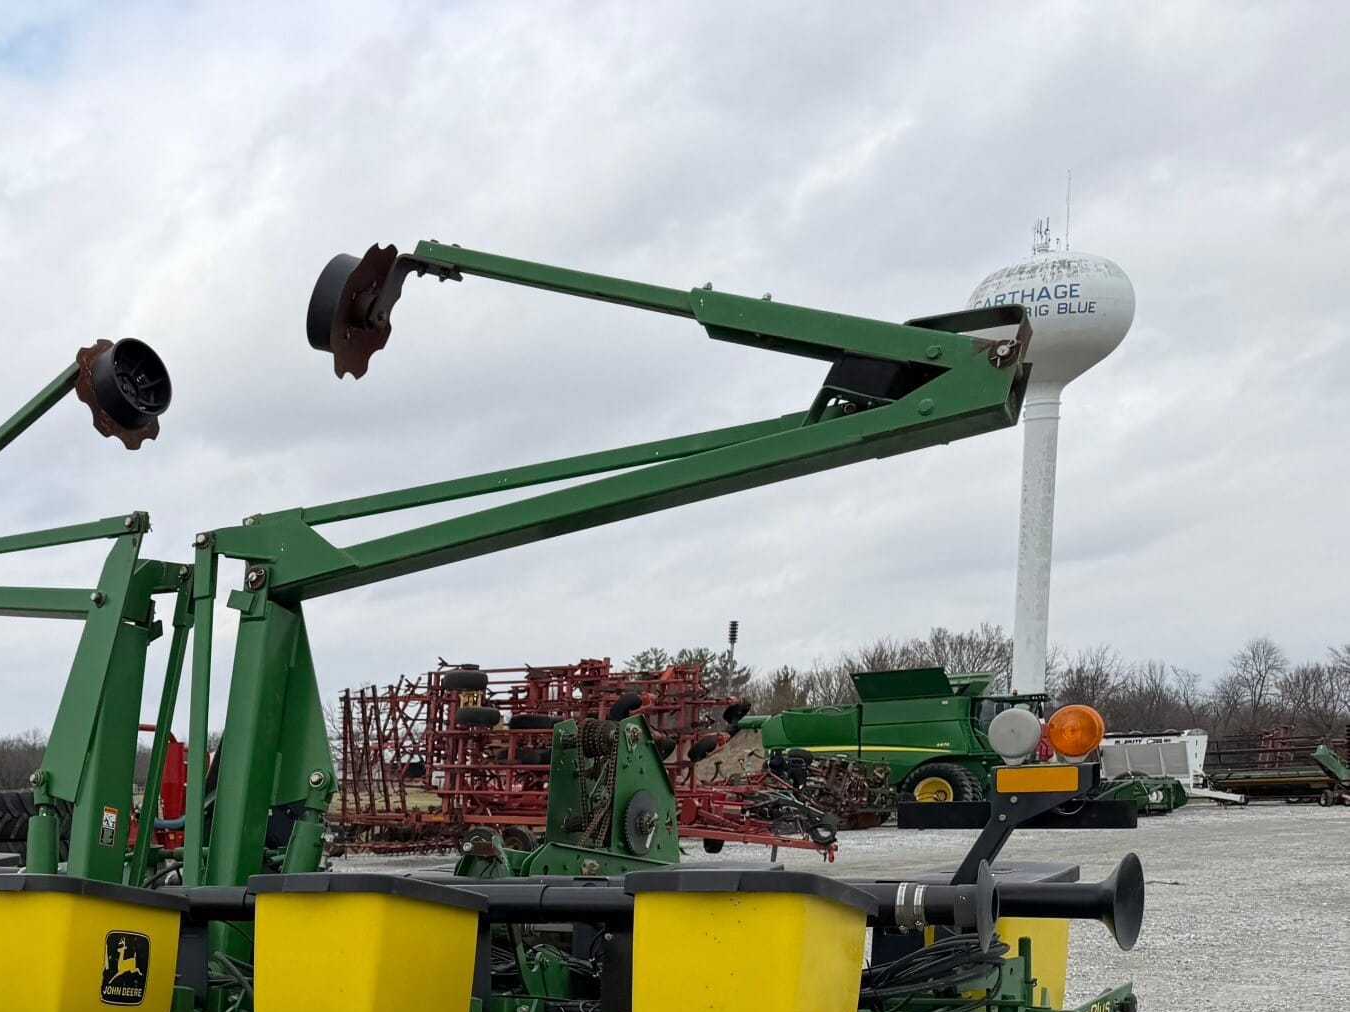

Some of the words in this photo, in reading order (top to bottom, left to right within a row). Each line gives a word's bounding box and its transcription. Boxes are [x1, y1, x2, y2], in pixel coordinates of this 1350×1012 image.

[1057, 301, 1097, 315] BLUE
[103, 985, 121, 996] JOHN
[122, 987, 143, 997] DEERE
